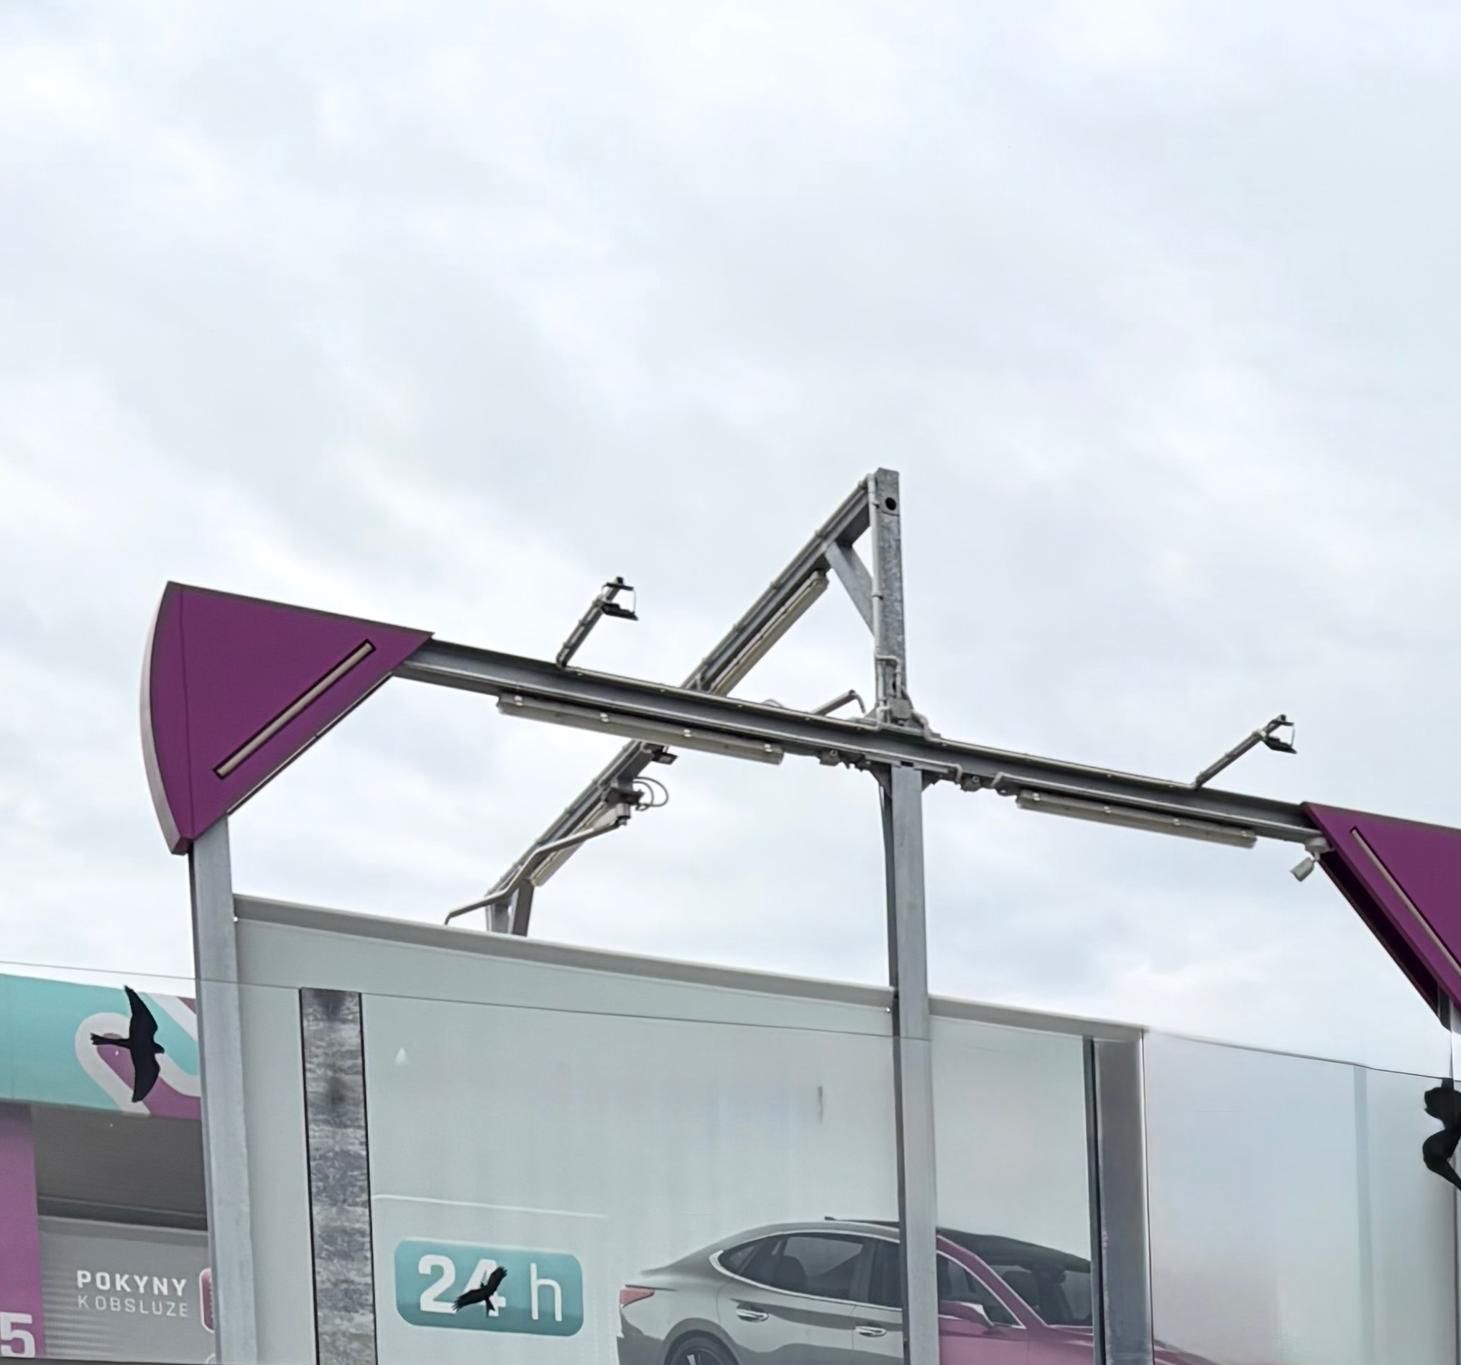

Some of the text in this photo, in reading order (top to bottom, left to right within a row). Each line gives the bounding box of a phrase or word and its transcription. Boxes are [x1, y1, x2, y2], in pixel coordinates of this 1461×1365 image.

[76, 1269, 188, 1297] POKYNY
[418, 1254, 563, 1322] 24 h
[77, 1296, 189, 1318] K OBSLUZE
